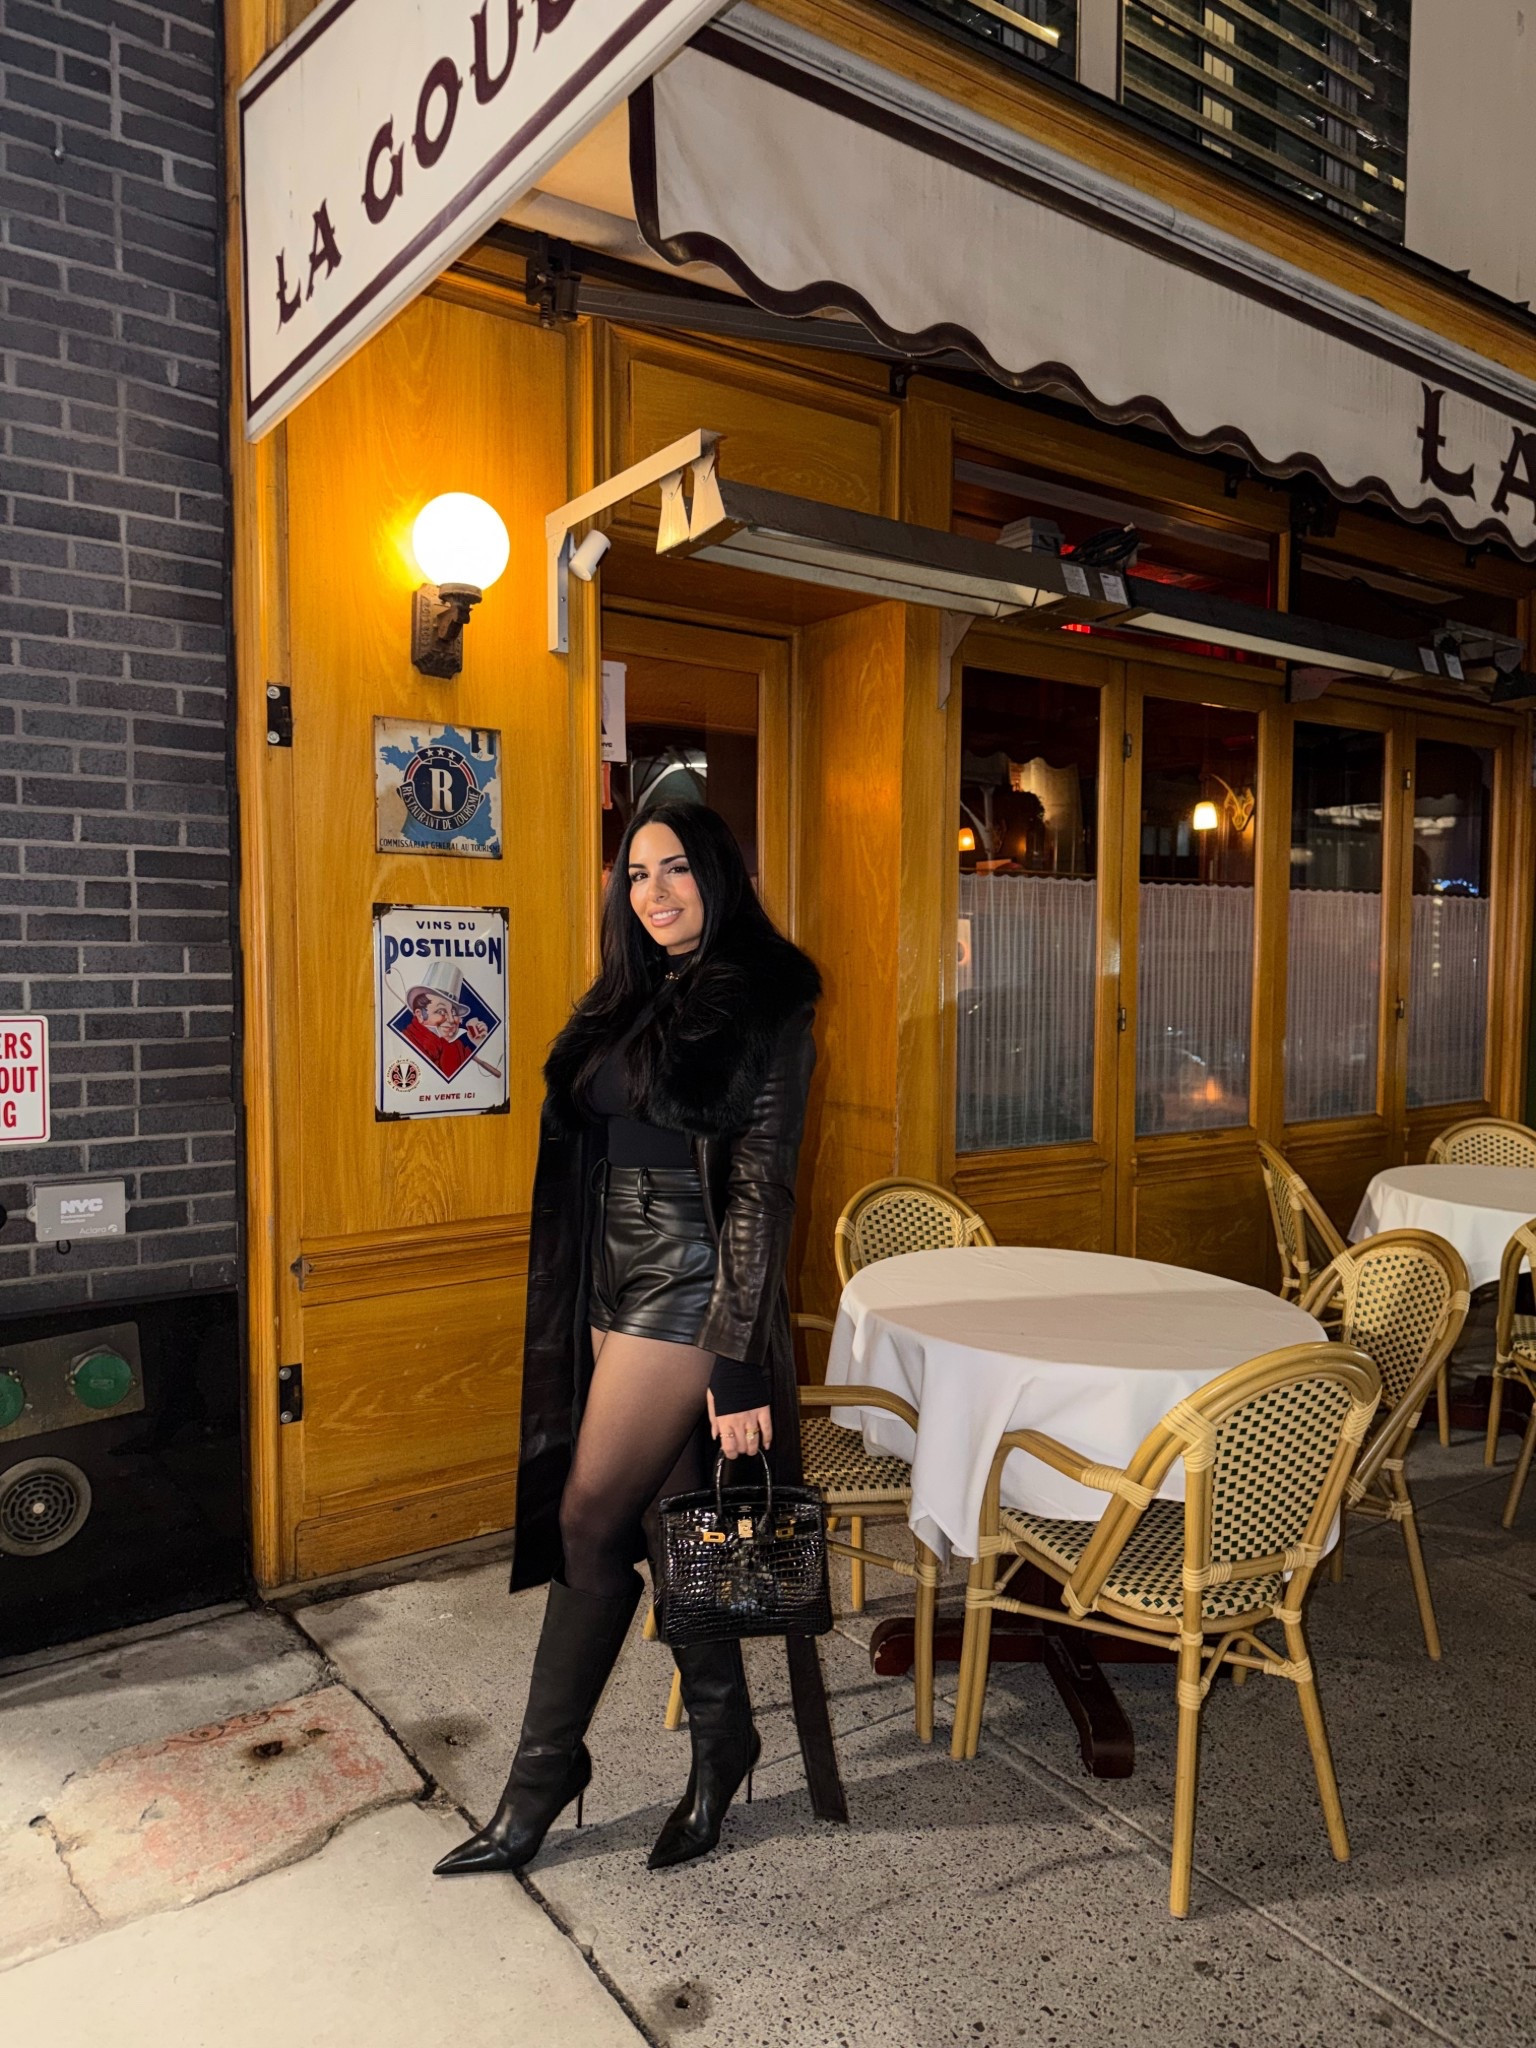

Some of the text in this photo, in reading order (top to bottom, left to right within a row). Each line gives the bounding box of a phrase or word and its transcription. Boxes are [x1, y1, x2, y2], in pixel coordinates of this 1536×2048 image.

[276, 198, 342, 334] LA
[1417, 382, 1536, 526] LA
[402, 785, 480, 830] RESTAURANT DE TOURISME
[429, 768, 454, 812] R
[379, 838, 429, 849] COMMISSARIAT
[461, 843, 469, 851] AU
[471, 843, 500, 853] TOURISME
[416, 920, 475, 930] VINS DU
[384, 935, 501, 974] POSTILLON
[0, 1032, 32, 1059] RS
[61, 1198, 103, 1214] NYC
